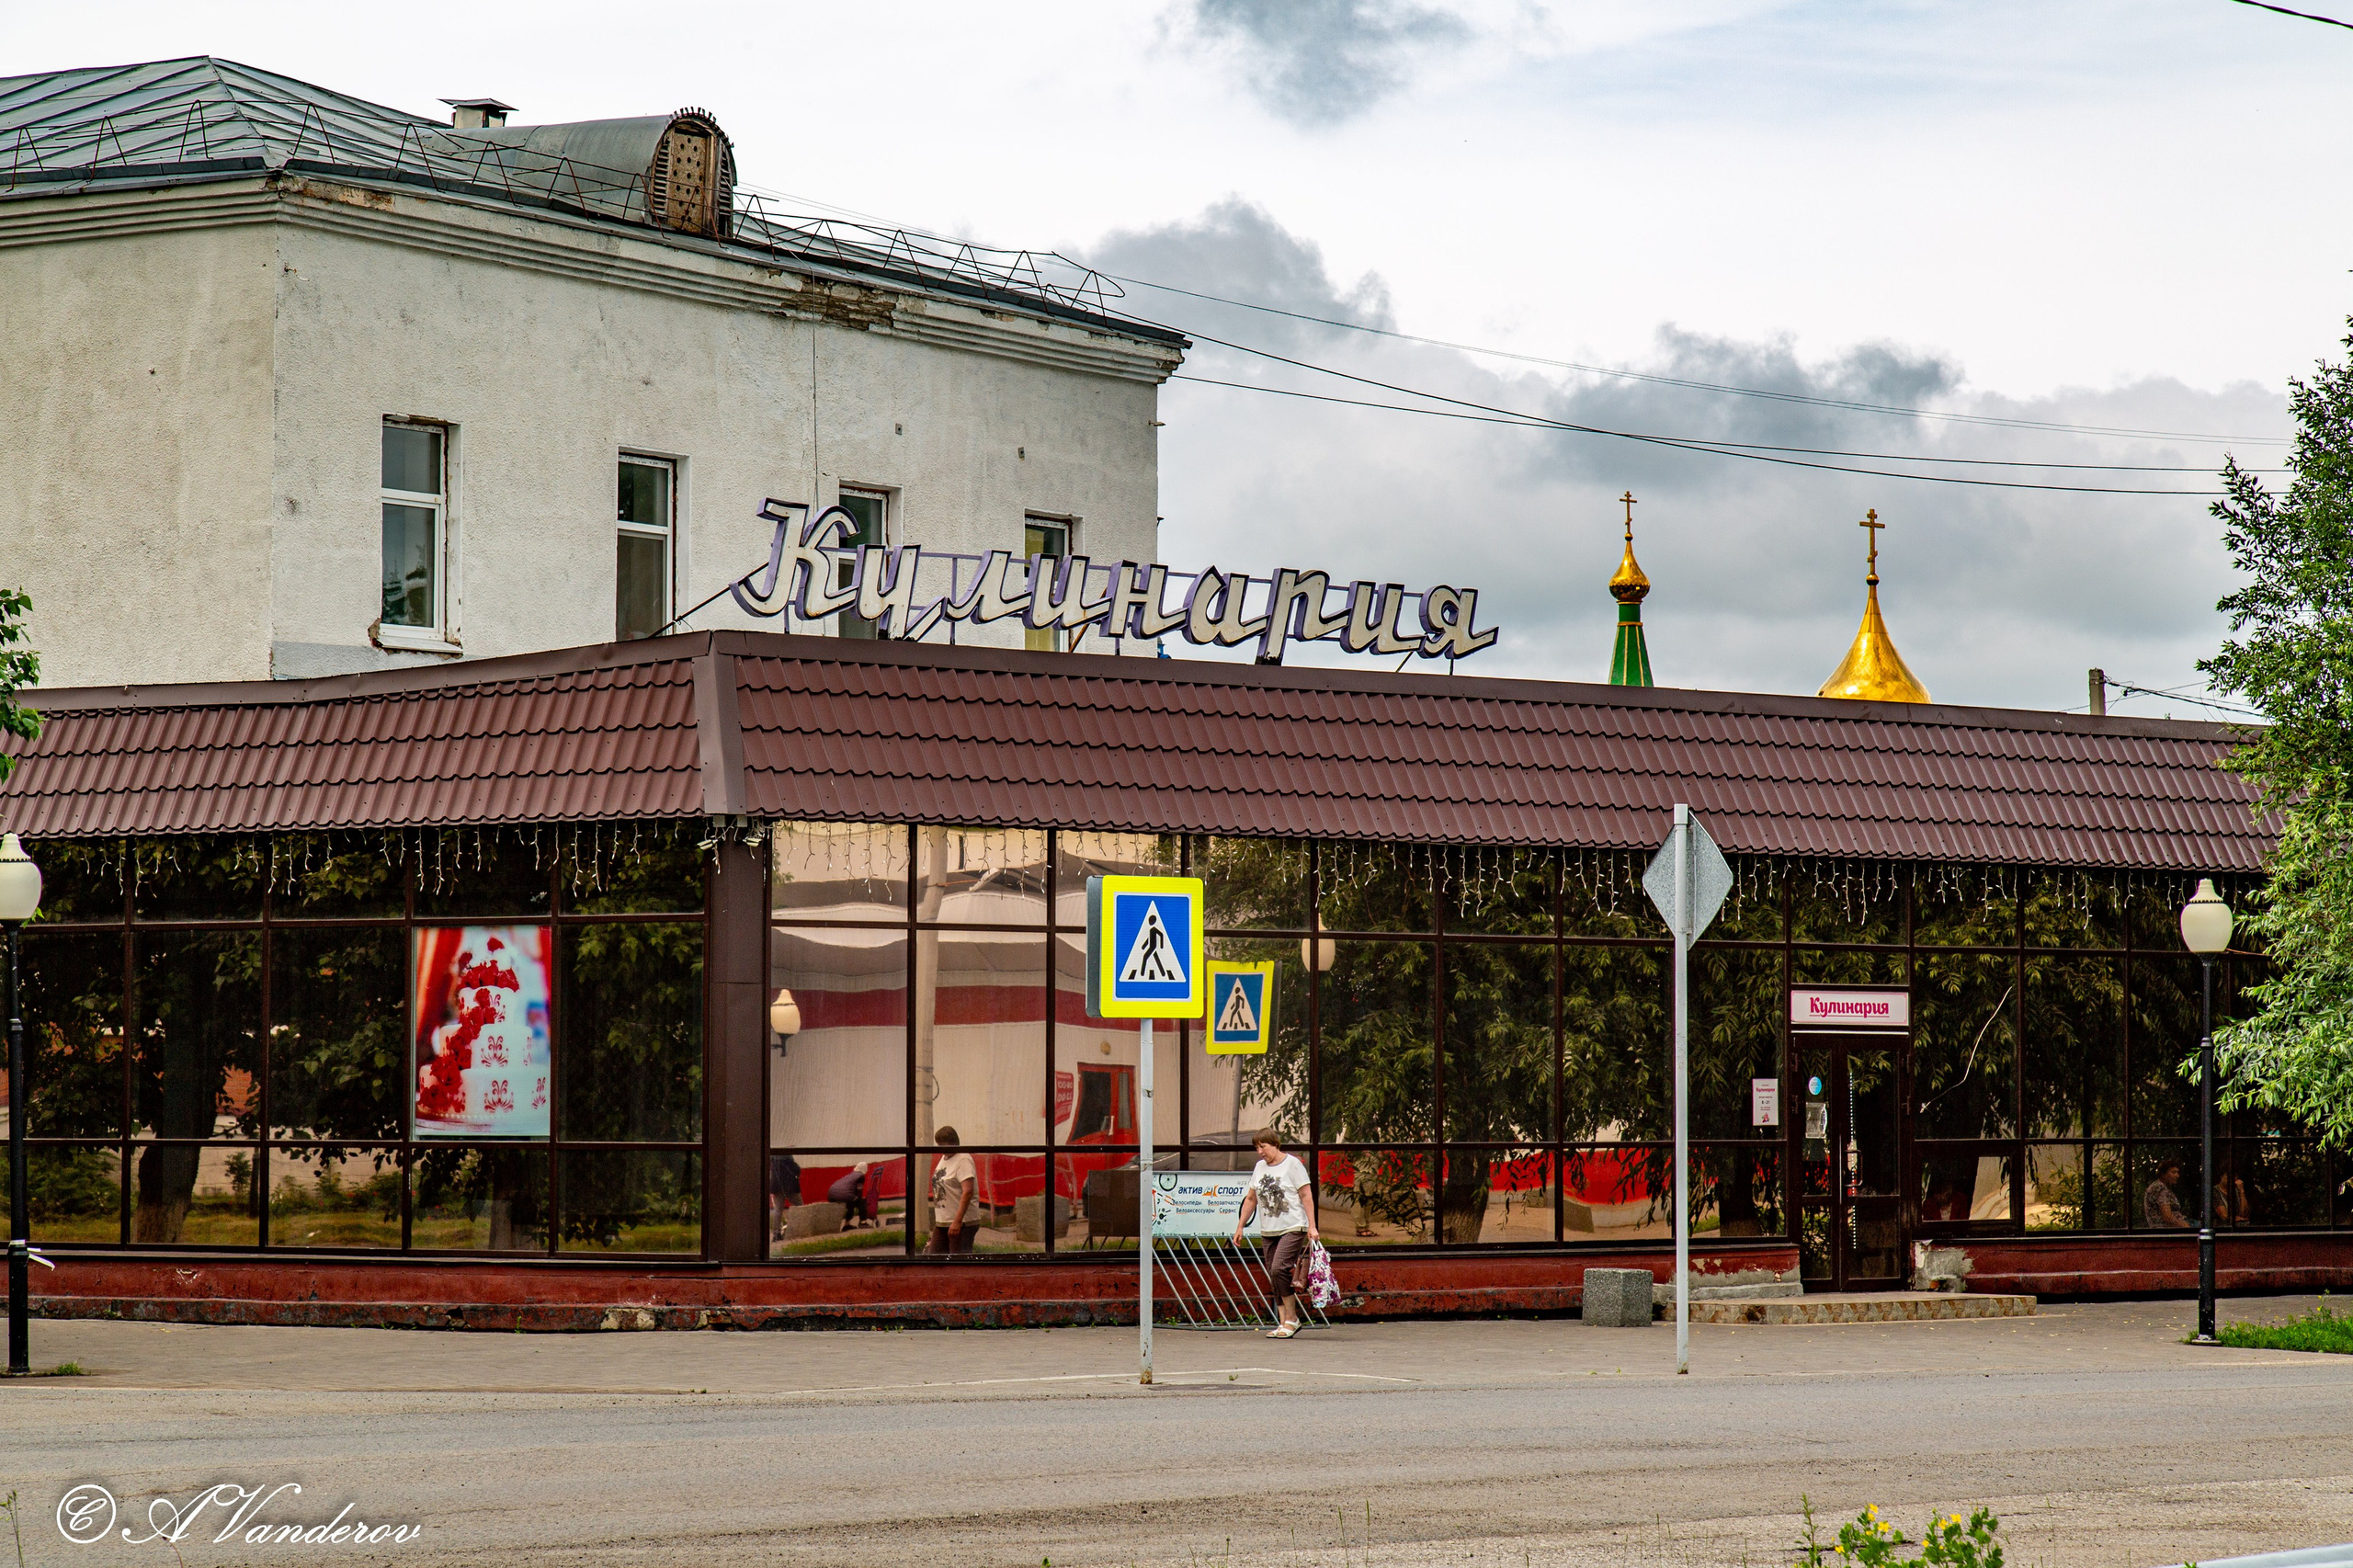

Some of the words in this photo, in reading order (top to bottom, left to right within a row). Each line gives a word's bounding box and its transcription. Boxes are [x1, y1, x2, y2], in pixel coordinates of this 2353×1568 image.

[730, 497, 1500, 665] Кулинария
[1809, 997, 1889, 1017] Кулинария
[1217, 1186, 1245, 1197] спорт
